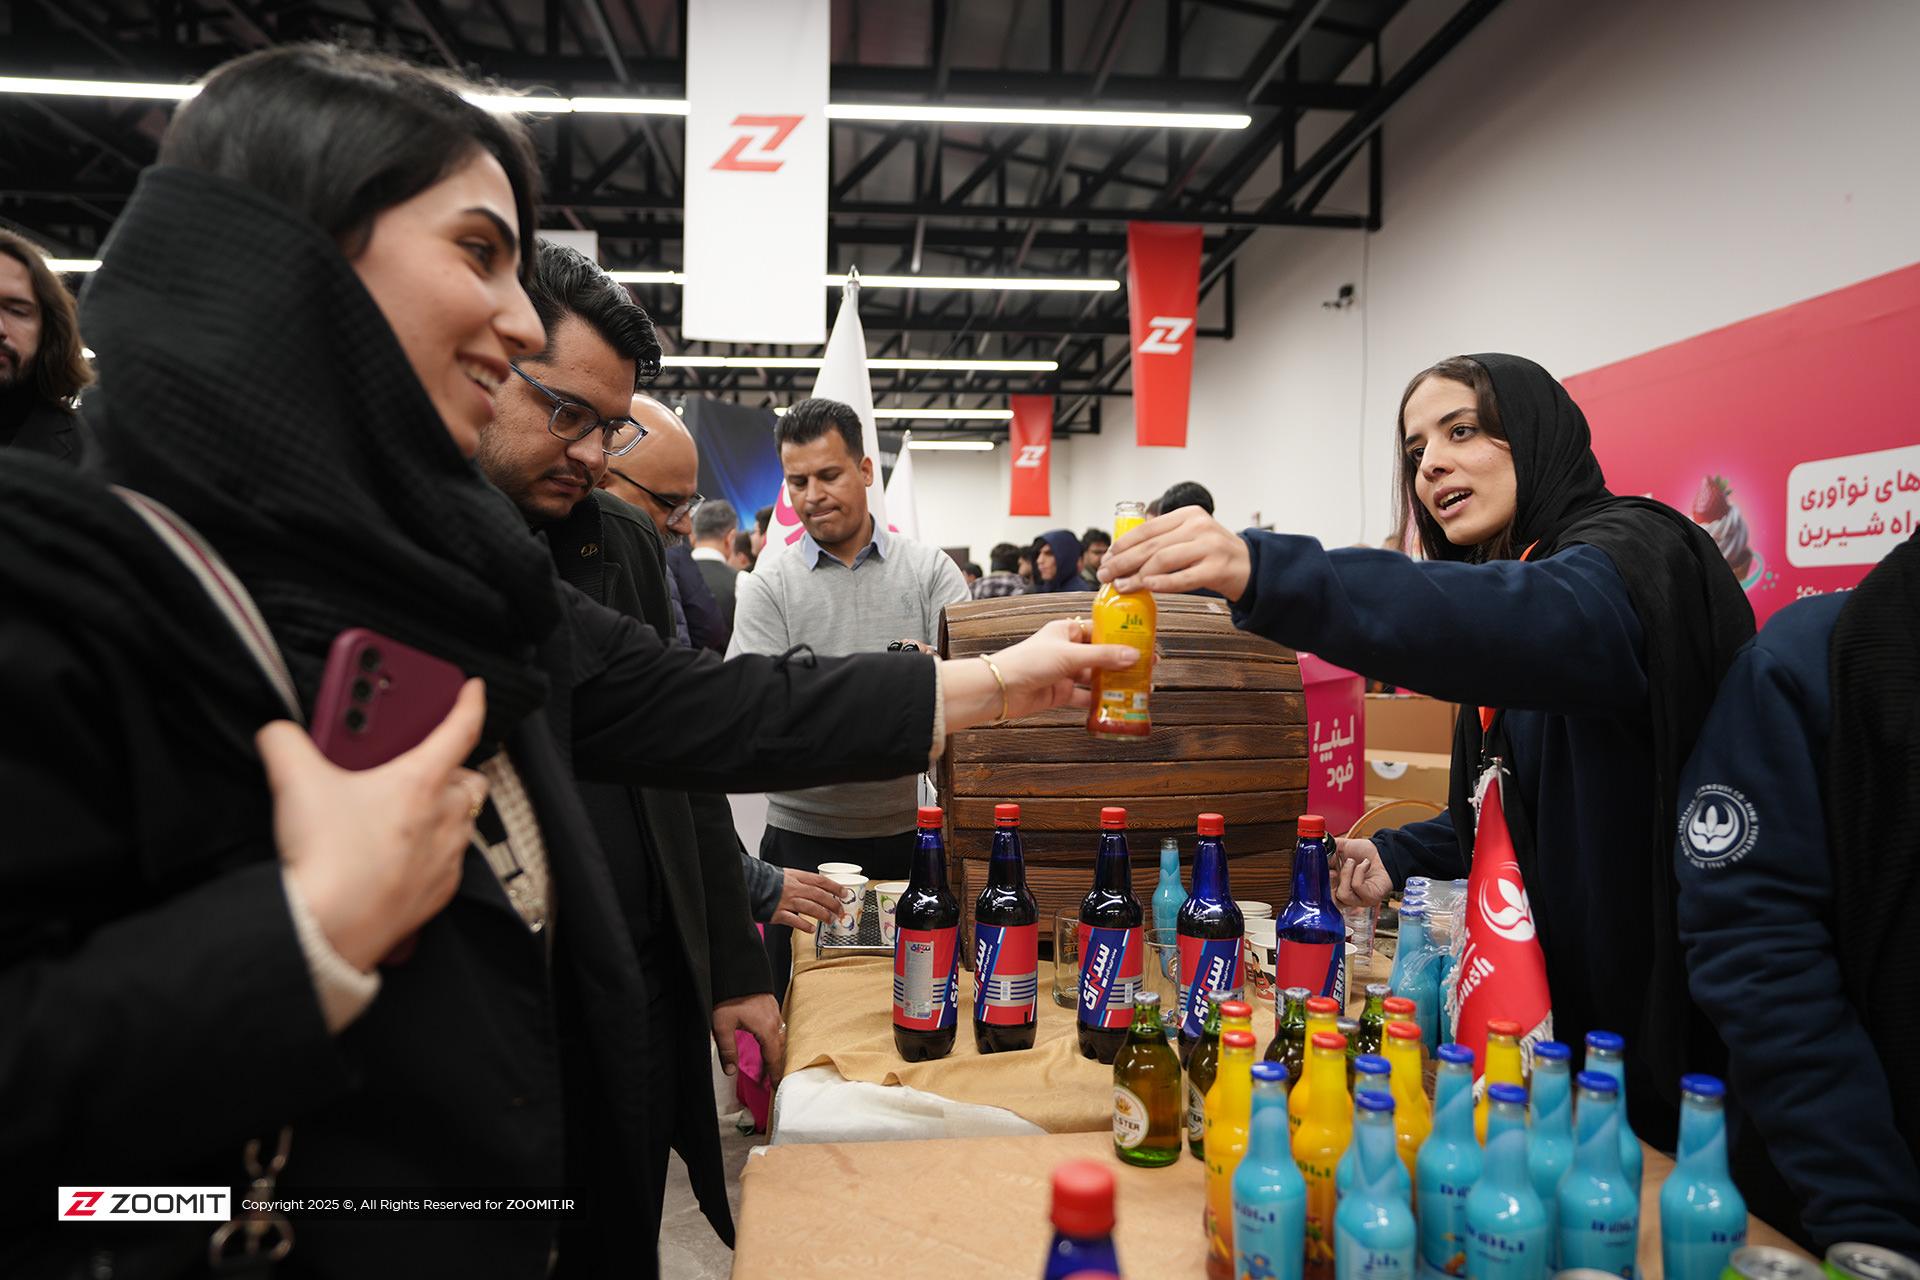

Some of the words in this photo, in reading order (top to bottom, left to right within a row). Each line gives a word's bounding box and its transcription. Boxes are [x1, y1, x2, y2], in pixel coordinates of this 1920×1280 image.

[1800, 476, 1868, 511] نوآوری
[1798, 512, 1885, 548] شیرین
[1327, 755, 1354, 792] فود
